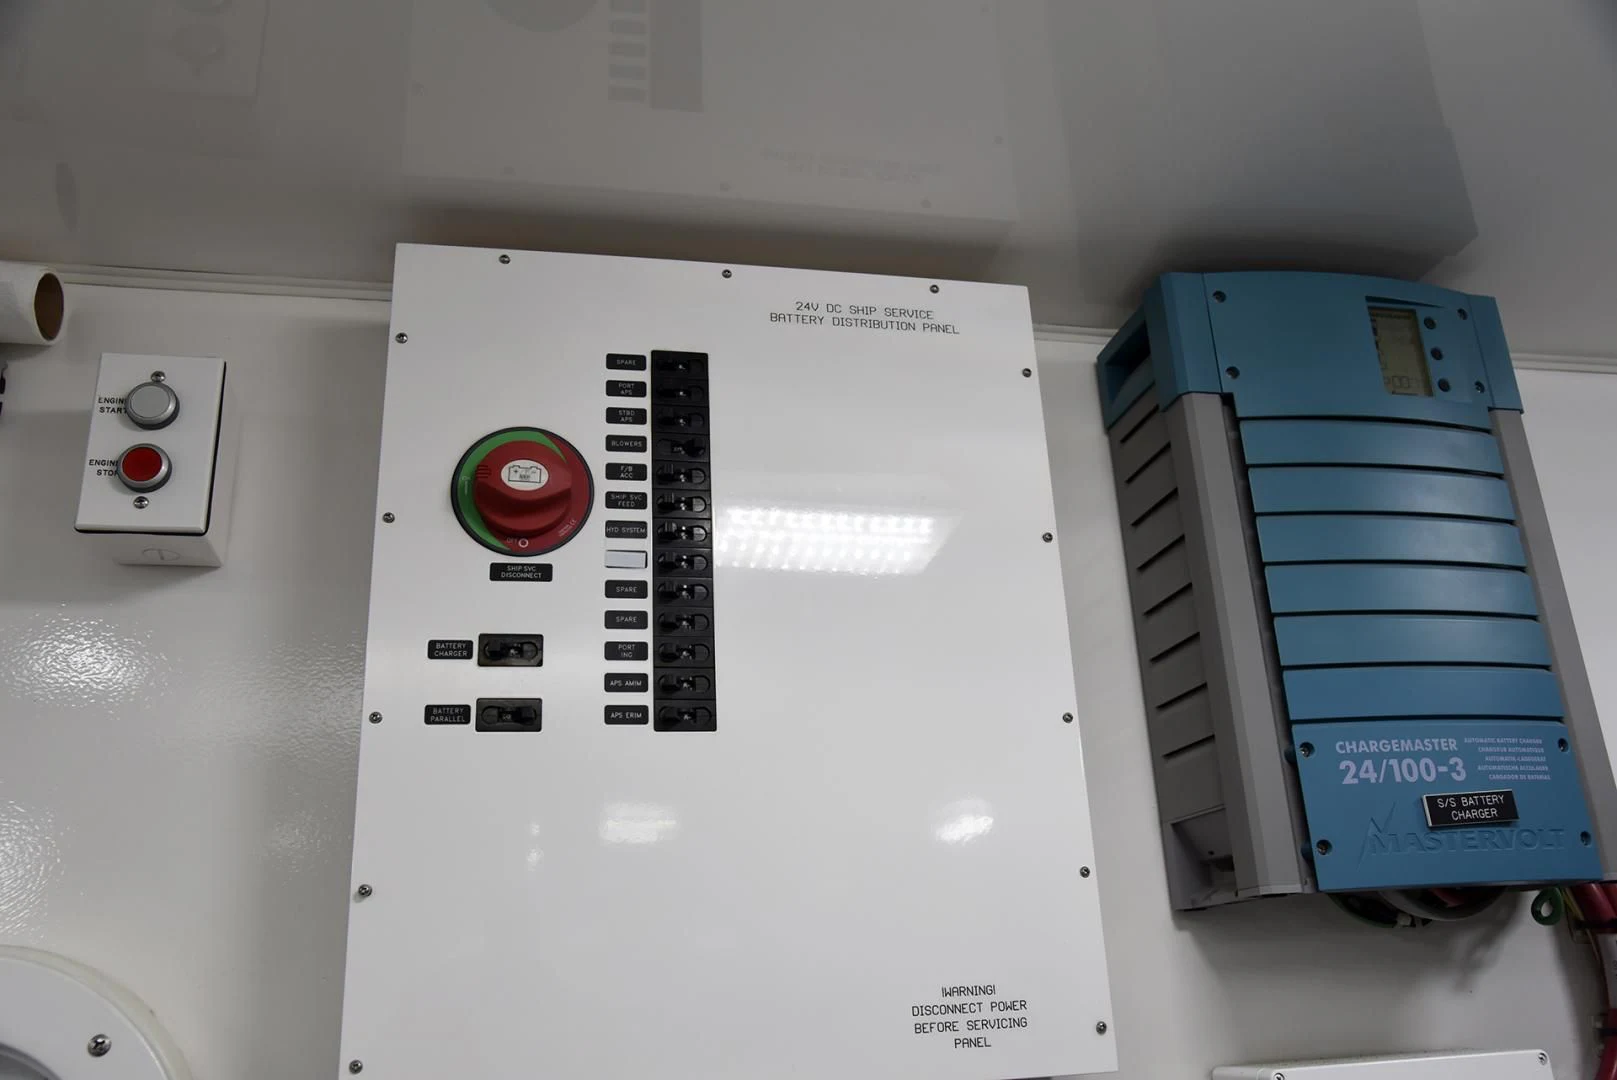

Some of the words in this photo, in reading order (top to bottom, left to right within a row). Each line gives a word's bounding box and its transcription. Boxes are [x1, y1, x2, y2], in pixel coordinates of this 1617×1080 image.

[795, 301, 819, 312] 24V
[826, 304, 842, 313] DC
[849, 305, 877, 315] SHIP
[884, 307, 934, 320] SERVICE
[770, 313, 824, 325] BATTERY
[832, 317, 916, 331] DISTRIBUTION
[923, 322, 960, 335] PANEL
[1335, 738, 1458, 754] CHARGEMASTER
[1339, 756, 1467, 785] 24/100-3
[1437, 797, 1457, 809] S/S
[1461, 794, 1505, 807] BATTERY
[1451, 808, 1498, 821] CHARGER
[1367, 828, 1565, 855] MASTERVOLT
[911, 1002, 983, 1016] DISCONNECT
[990, 1000, 1027, 1012] POWER
[914, 1021, 959, 1034] BEFORE
[966, 1017, 1028, 1031] SERVICING
[954, 1036, 991, 1048] PANEL
